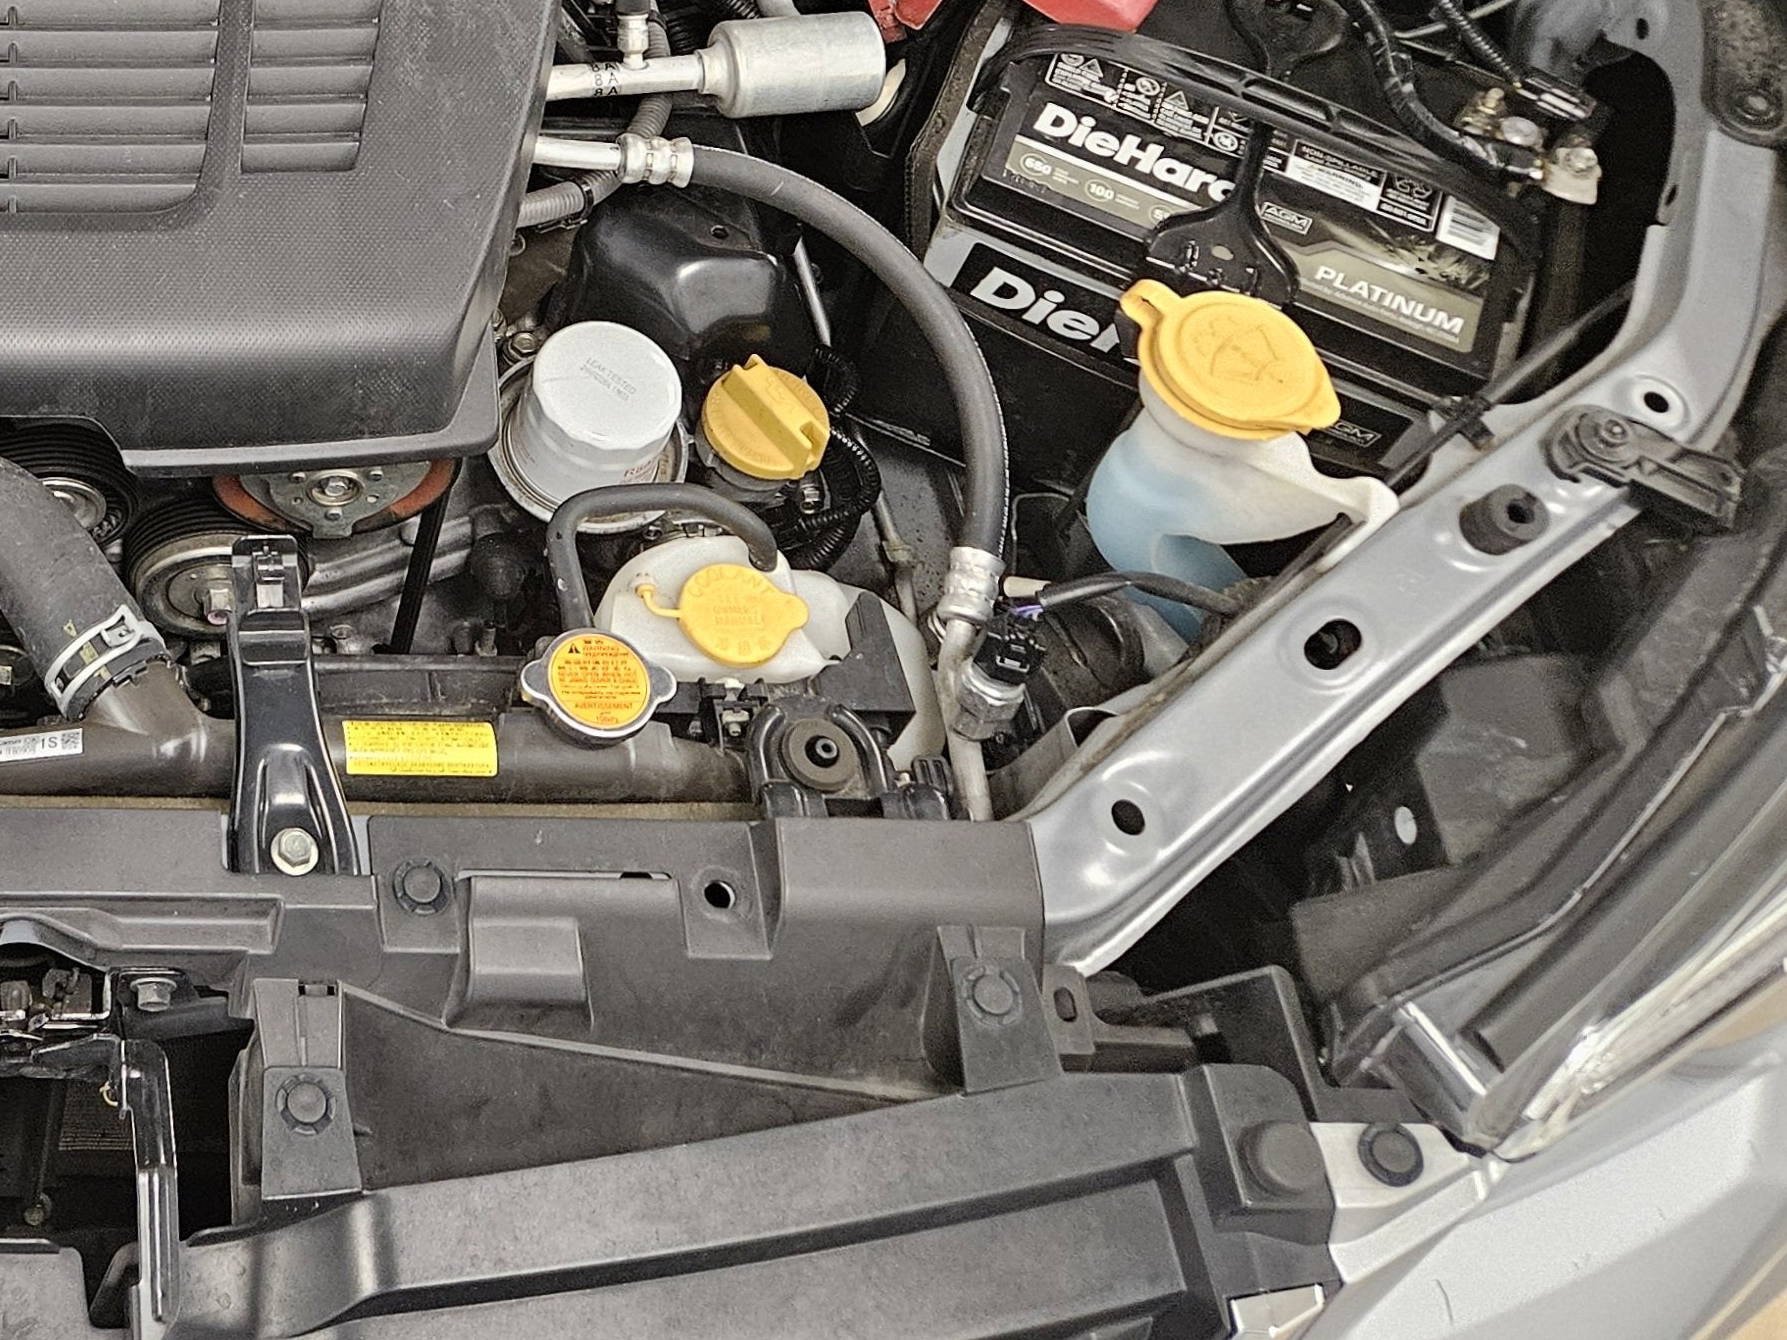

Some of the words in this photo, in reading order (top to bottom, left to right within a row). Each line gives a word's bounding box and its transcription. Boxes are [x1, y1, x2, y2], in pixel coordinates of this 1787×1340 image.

[1024, 157, 1053, 175] 650
[1088, 182, 1116, 200] 100
[1265, 205, 1309, 227] AGM
[1314, 264, 1465, 334] PLATINUM
[1334, 422, 1374, 440] GM
